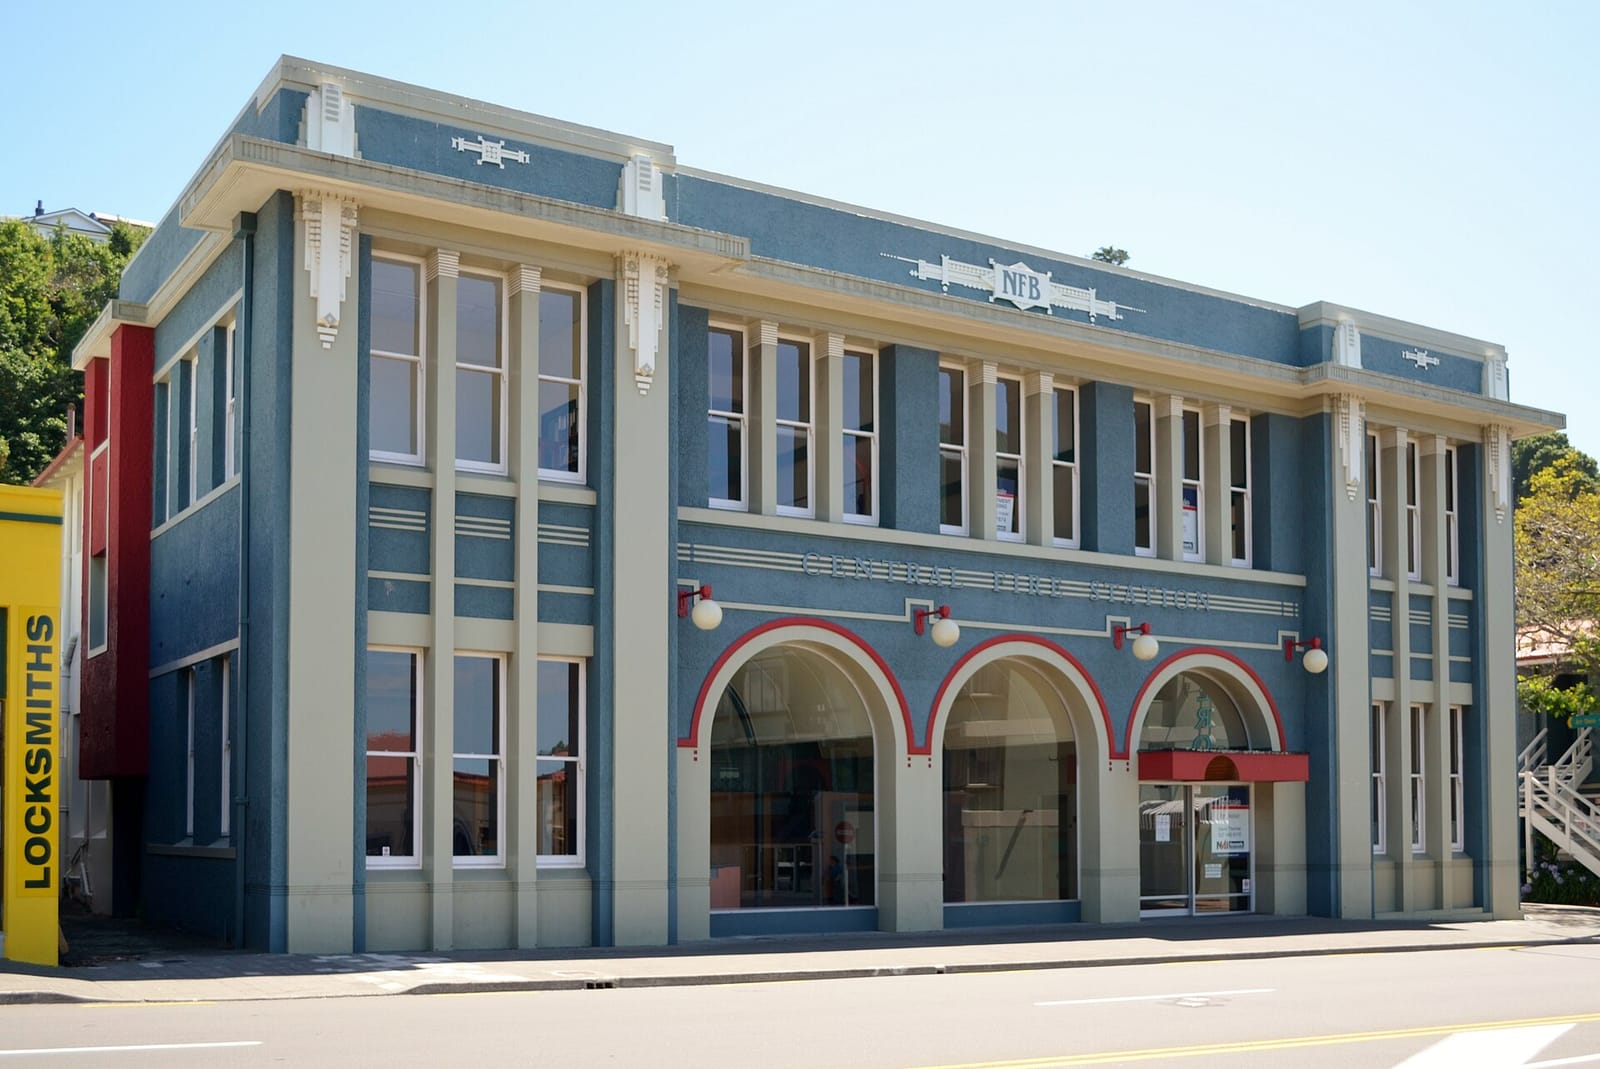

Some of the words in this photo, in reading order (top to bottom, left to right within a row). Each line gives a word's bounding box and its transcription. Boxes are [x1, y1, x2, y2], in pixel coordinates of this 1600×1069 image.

[1002, 269, 1041, 300] NFB
[802, 552, 964, 588] CENTRAL
[992, 570, 1063, 598] FIRE
[1089, 580, 1210, 611] STATION
[24, 614, 54, 889] LOCKSMITHS
